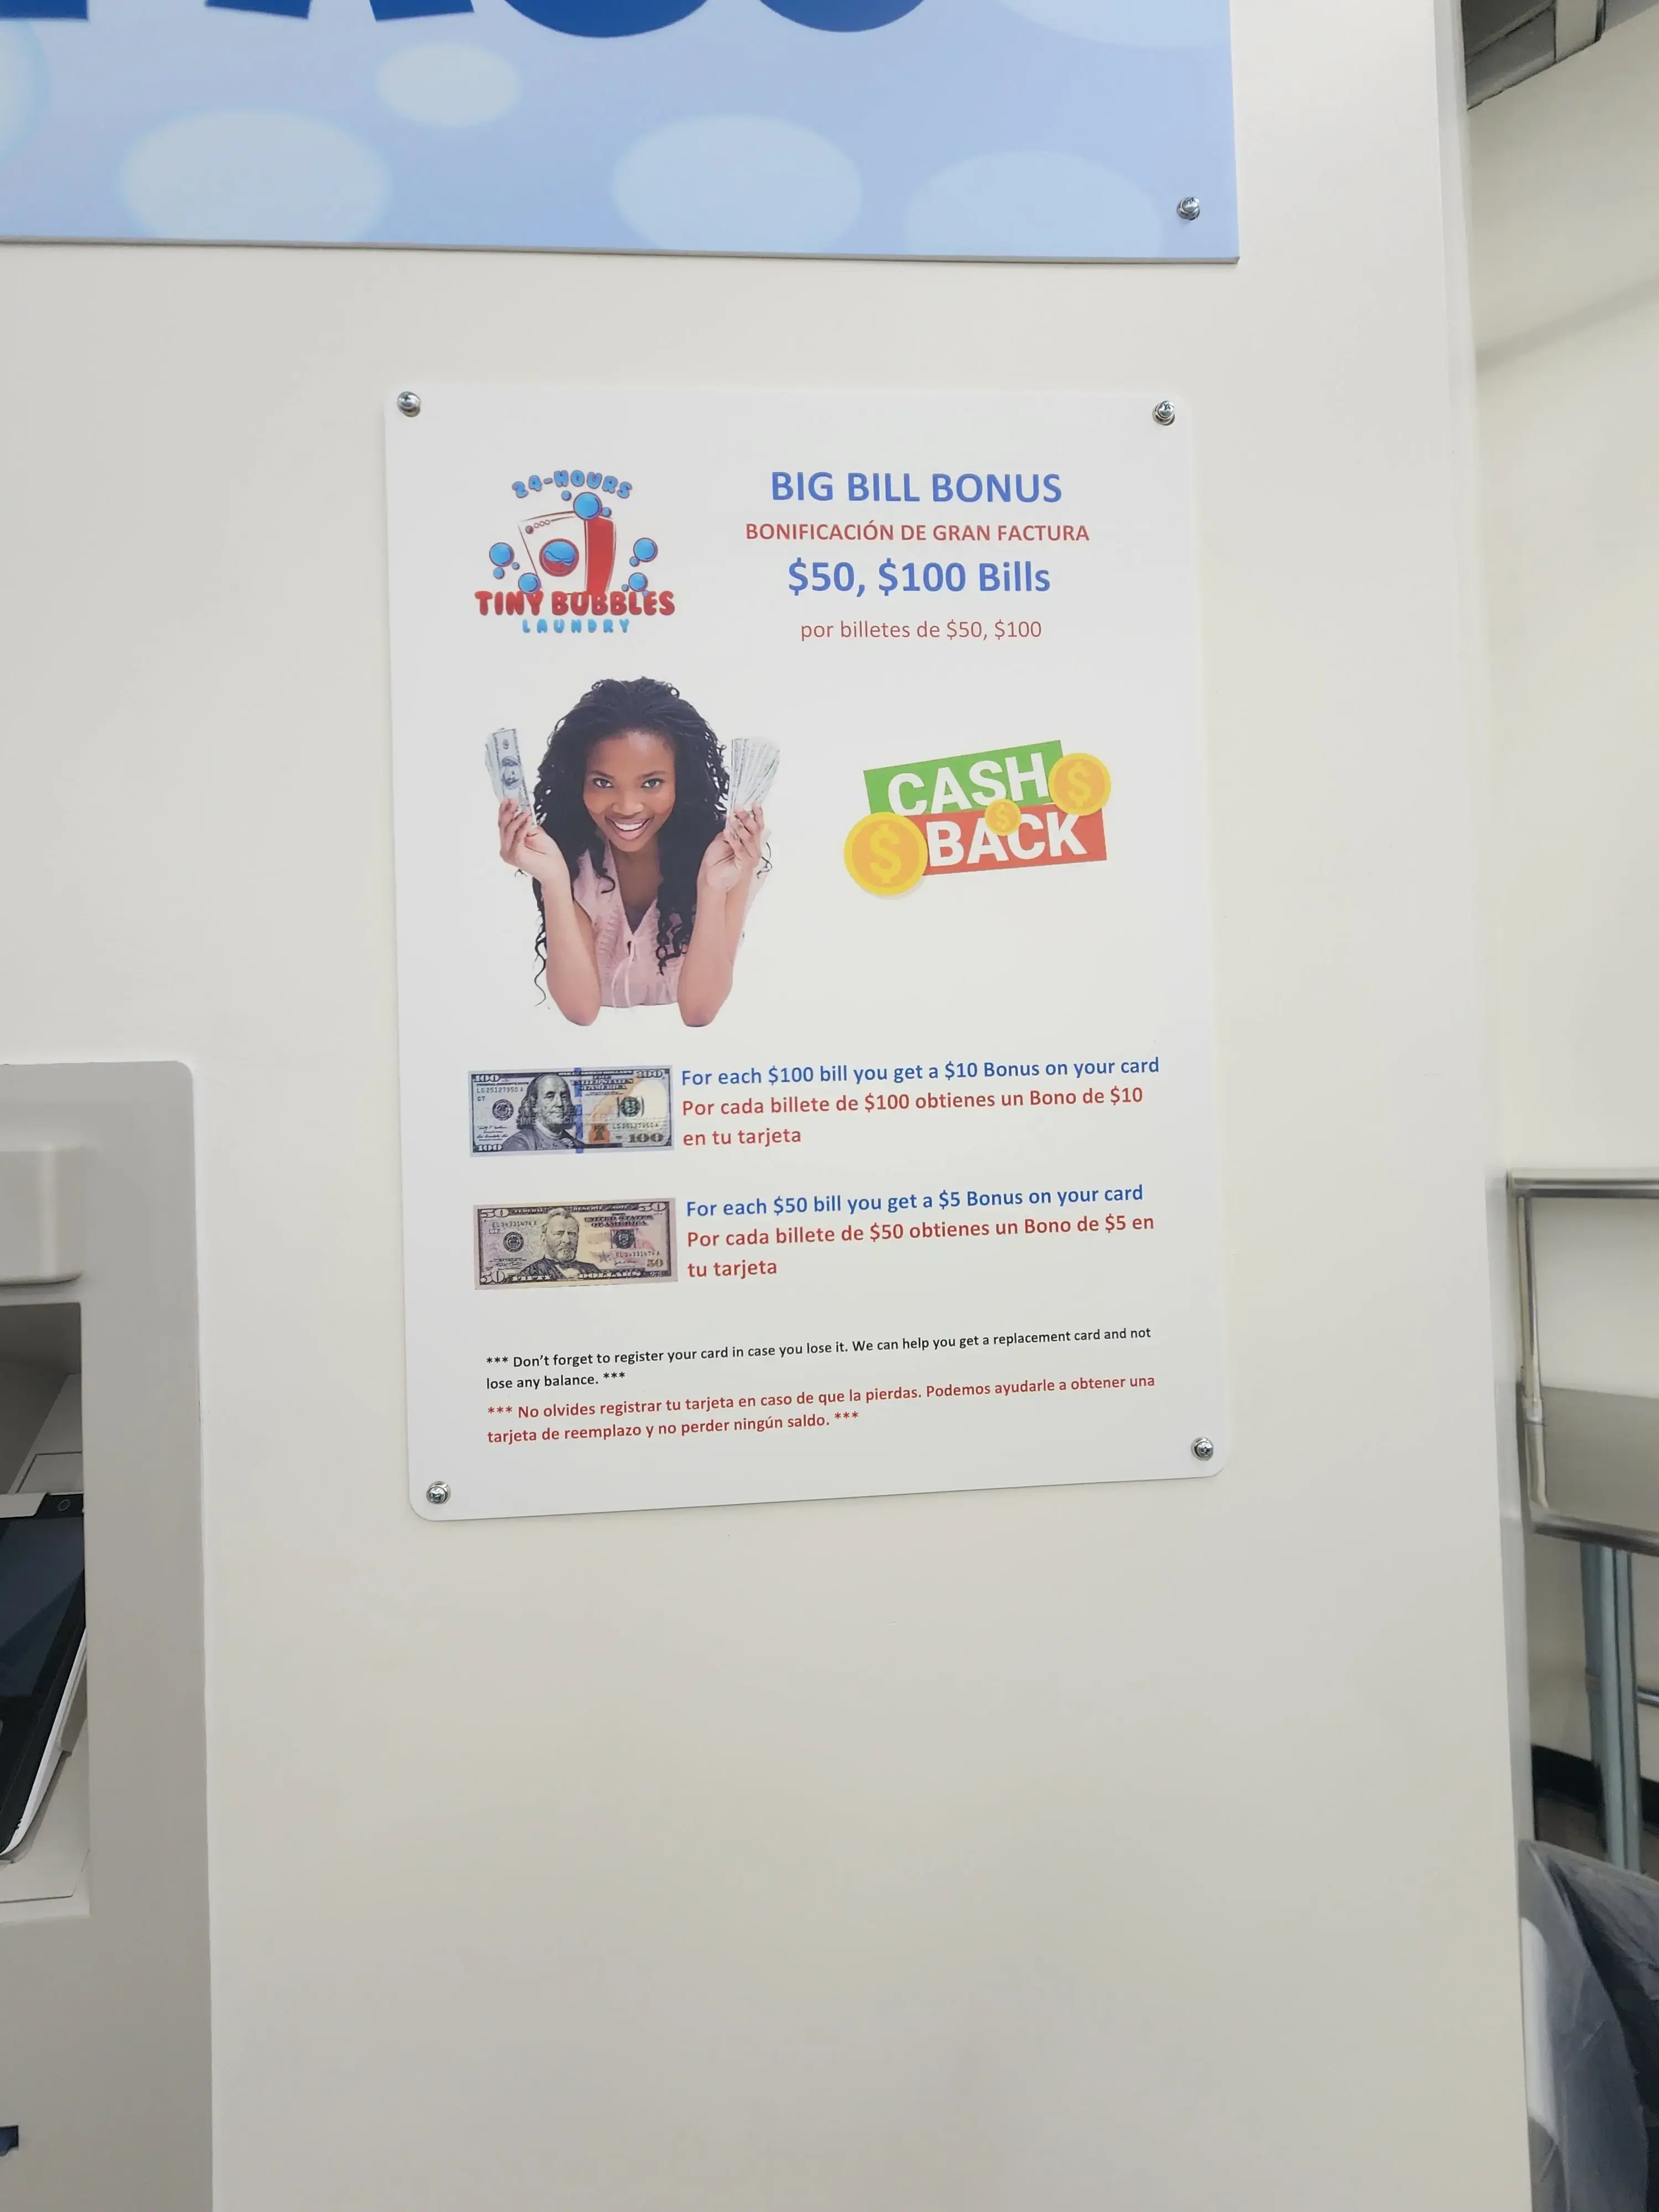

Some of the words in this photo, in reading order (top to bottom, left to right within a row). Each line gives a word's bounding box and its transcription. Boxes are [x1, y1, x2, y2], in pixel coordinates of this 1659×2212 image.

[512, 469, 633, 499] 24-HOURS
[771, 471, 833, 502] BIG
[847, 472, 921, 502] BILL
[932, 473, 1062, 503] BONUS
[745, 519, 894, 541] BONIFICACIÓN
[901, 524, 927, 541] DE
[932, 524, 990, 541] GRAN
[998, 525, 1090, 541] FACTURA
[788, 557, 865, 598] $50,
[878, 557, 966, 597] $100
[979, 560, 1051, 592] Bills
[474, 590, 544, 616] TINY
[551, 590, 675, 616] BUBBLES
[522, 618, 630, 633] LAUNDRY
[801, 625, 834, 642] por
[841, 620, 911, 638] billetes
[916, 620, 940, 638] de
[946, 618, 988, 641] $50,
[994, 618, 1042, 641] $100
[888, 752, 1050, 816] CASH
[926, 811, 1088, 867] BACK
[681, 1070, 713, 1086] For
[718, 1067, 763, 1085] each
[768, 1065, 814, 1087] $100
[820, 1065, 848, 1082] bill
[853, 1068, 888, 1085] you
[893, 1065, 924, 1084] get
[928, 1067, 938, 1079] a
[944, 1060, 978, 1081] $10
[984, 1061, 1040, 1077] Bonus
[1045, 1063, 1068, 1076] on
[1073, 1062, 1116, 1079] your
[1120, 1056, 1160, 1074] card
[682, 1100, 715, 1117] Por
[721, 1097, 764, 1115] cada
[770, 1095, 830, 1113] billete
[836, 1094, 859, 1112] de
[864, 1092, 910, 1113] $100
[915, 1092, 996, 1109] obtienes
[1001, 1094, 1024, 1107] un
[1030, 1090, 1077, 1105] Bono
[1082, 1087, 1105, 1104] de
[1110, 1085, 1143, 1106] $10
[629, 1133, 664, 1143] 100
[682, 1133, 706, 1146] en
[711, 1130, 732, 1145] tu
[737, 1127, 801, 1147] tarjeta
[480, 1208, 510, 1218] 50
[638, 1202, 667, 1212] 50
[686, 1201, 718, 1217] For
[723, 1197, 767, 1216] each
[773, 1195, 808, 1217] $50
[813, 1194, 842, 1213] bill
[847, 1198, 882, 1215] you
[887, 1194, 918, 1214] get
[922, 1196, 933, 1208] a
[938, 1189, 961, 1211] $5
[967, 1191, 1024, 1207] Bonus
[1029, 1192, 1052, 1204] on
[1056, 1190, 1099, 1207] your
[1104, 1183, 1143, 1202] card
[687, 1232, 720, 1248] Por
[726, 1228, 769, 1246] cada
[776, 1226, 835, 1244] billete
[841, 1224, 864, 1241] de
[869, 1222, 904, 1243] $50
[909, 1221, 990, 1239] obtienes
[995, 1223, 1019, 1235] un
[1024, 1218, 1072, 1234] Bono
[1077, 1215, 1099, 1233] de
[1104, 1213, 1126, 1234] $5
[1131, 1217, 1155, 1230] en
[646, 1258, 664, 1268] 50
[687, 1262, 707, 1278] tu
[712, 1259, 777, 1280] tarjeta
[480, 1271, 505, 1284] 50
[552, 1354, 593, 1368] forget
[596, 1353, 611, 1364] to
[614, 1350, 664, 1365] register
[667, 1350, 697, 1363] your
[701, 1346, 728, 1359] card
[732, 1346, 744, 1358] in
[748, 1347, 775, 1357] case
[779, 1345, 802, 1358] you
[806, 1342, 832, 1354] lose
[836, 1341, 848, 1353] it.
[852, 1340, 873, 1352] We
[877, 1341, 899, 1350] can
[902, 1337, 930, 1351] help
[932, 1338, 956, 1350] you
[959, 1335, 979, 1349] get
[983, 1337, 989, 1345] a
[993, 1331, 1071, 1347] replacement
[1074, 1328, 1100, 1341] card
[1104, 1327, 1126, 1339] and
[1130, 1328, 1151, 1338] not
[486, 1378, 513, 1390] lose
[517, 1378, 541, 1390] any
[544, 1374, 599, 1387] balance.
[518, 1405, 539, 1418] No
[543, 1402, 596, 1417] olvides
[600, 1400, 662, 1417] registrar
[665, 1400, 681, 1411] tu
[685, 1396, 734, 1412] tarjeta
[738, 1397, 756, 1407] en
[760, 1395, 792, 1406] caso
[796, 1391, 814, 1405] de
[818, 1392, 845, 1406] que
[849, 1389, 862, 1402] la
[865, 1386, 922, 1404] pierdas.
[926, 1384, 991, 1398] Podemos
[994, 1378, 1055, 1396] ayudarle
[1058, 1381, 1067, 1391] a
[1071, 1376, 1126, 1390] obtener
[1129, 1377, 1155, 1387] una
[487, 1429, 537, 1446] tarjeta
[541, 1427, 560, 1441] de
[565, 1423, 642, 1441] reemplazo
[645, 1425, 654, 1438] y
[658, 1425, 677, 1434] no
[681, 1418, 730, 1437] perder
[734, 1415, 783, 1432] ningún
[787, 1413, 830, 1428] saldo.
